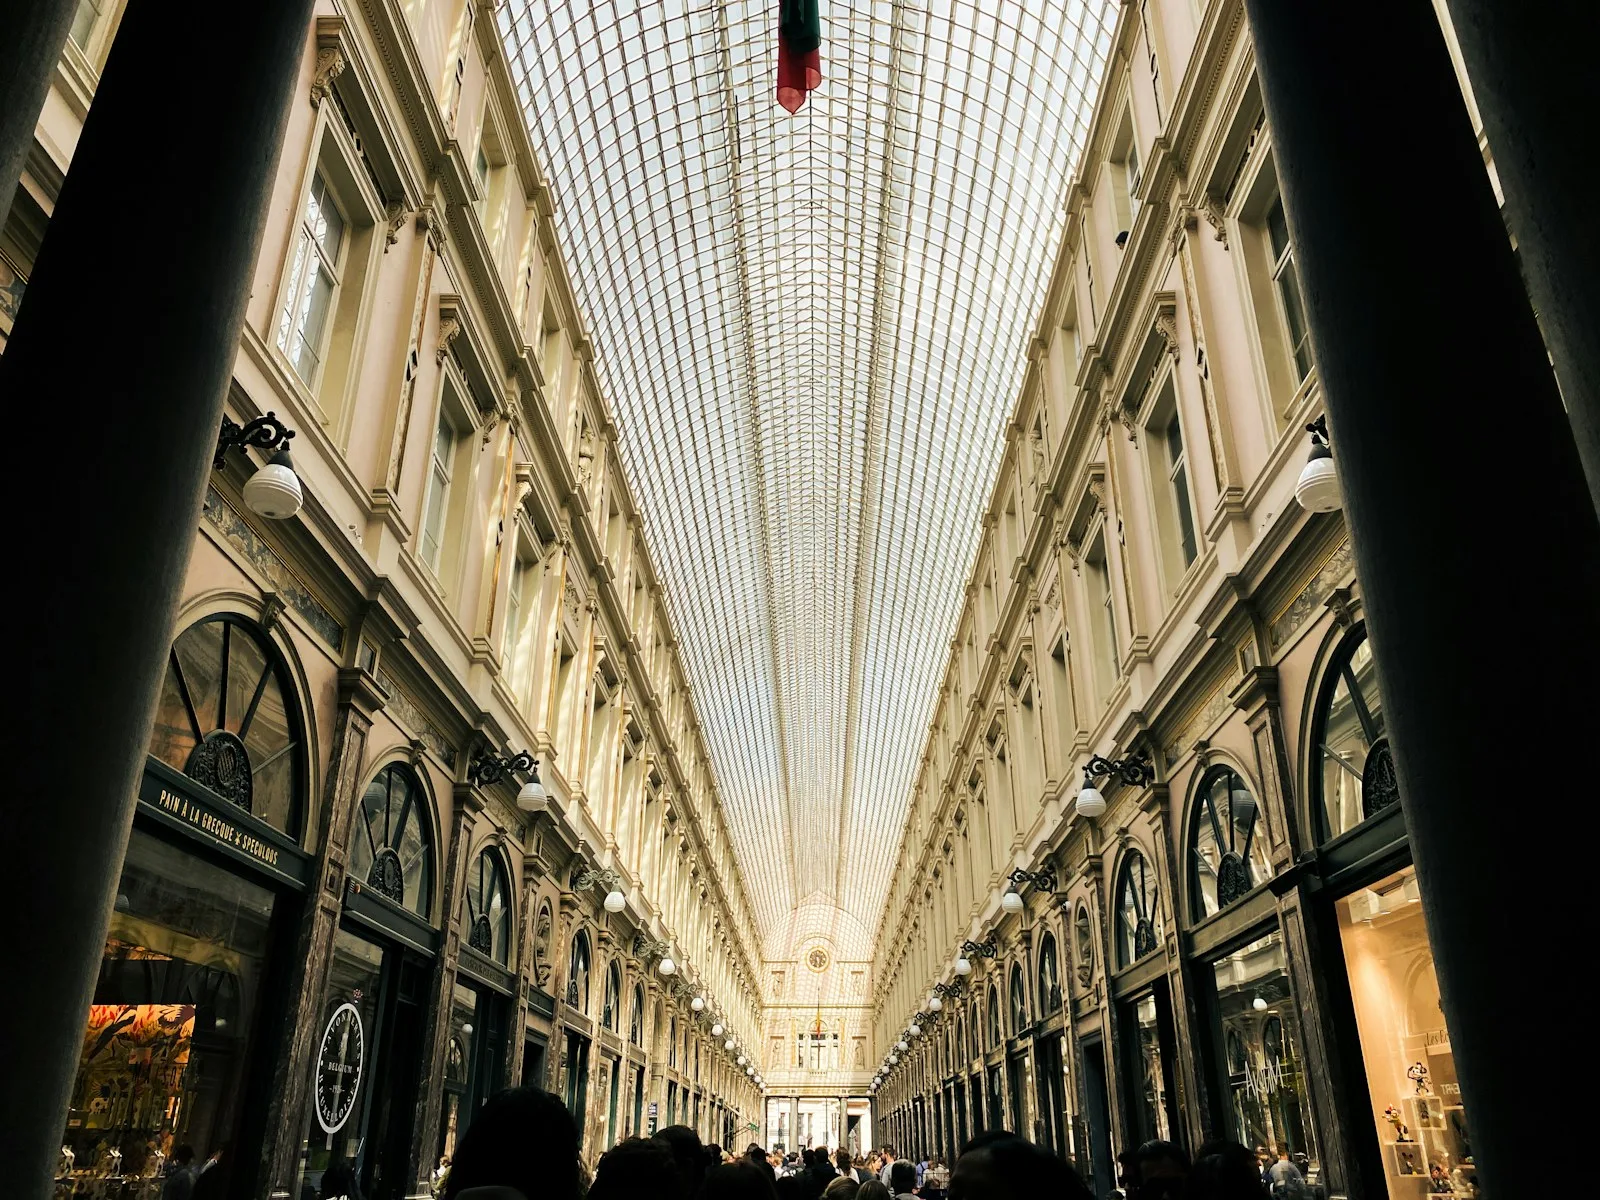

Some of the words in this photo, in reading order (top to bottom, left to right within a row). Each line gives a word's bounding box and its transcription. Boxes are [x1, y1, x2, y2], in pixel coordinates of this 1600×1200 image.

[159, 789, 180, 812] PAIN
[181, 799, 187, 818] À
[189, 806, 200, 824] LA
[202, 812, 234, 841] GRECQUE
[242, 834, 278, 865] SPECULOOS
[327, 1061, 353, 1074] BELGIUM
